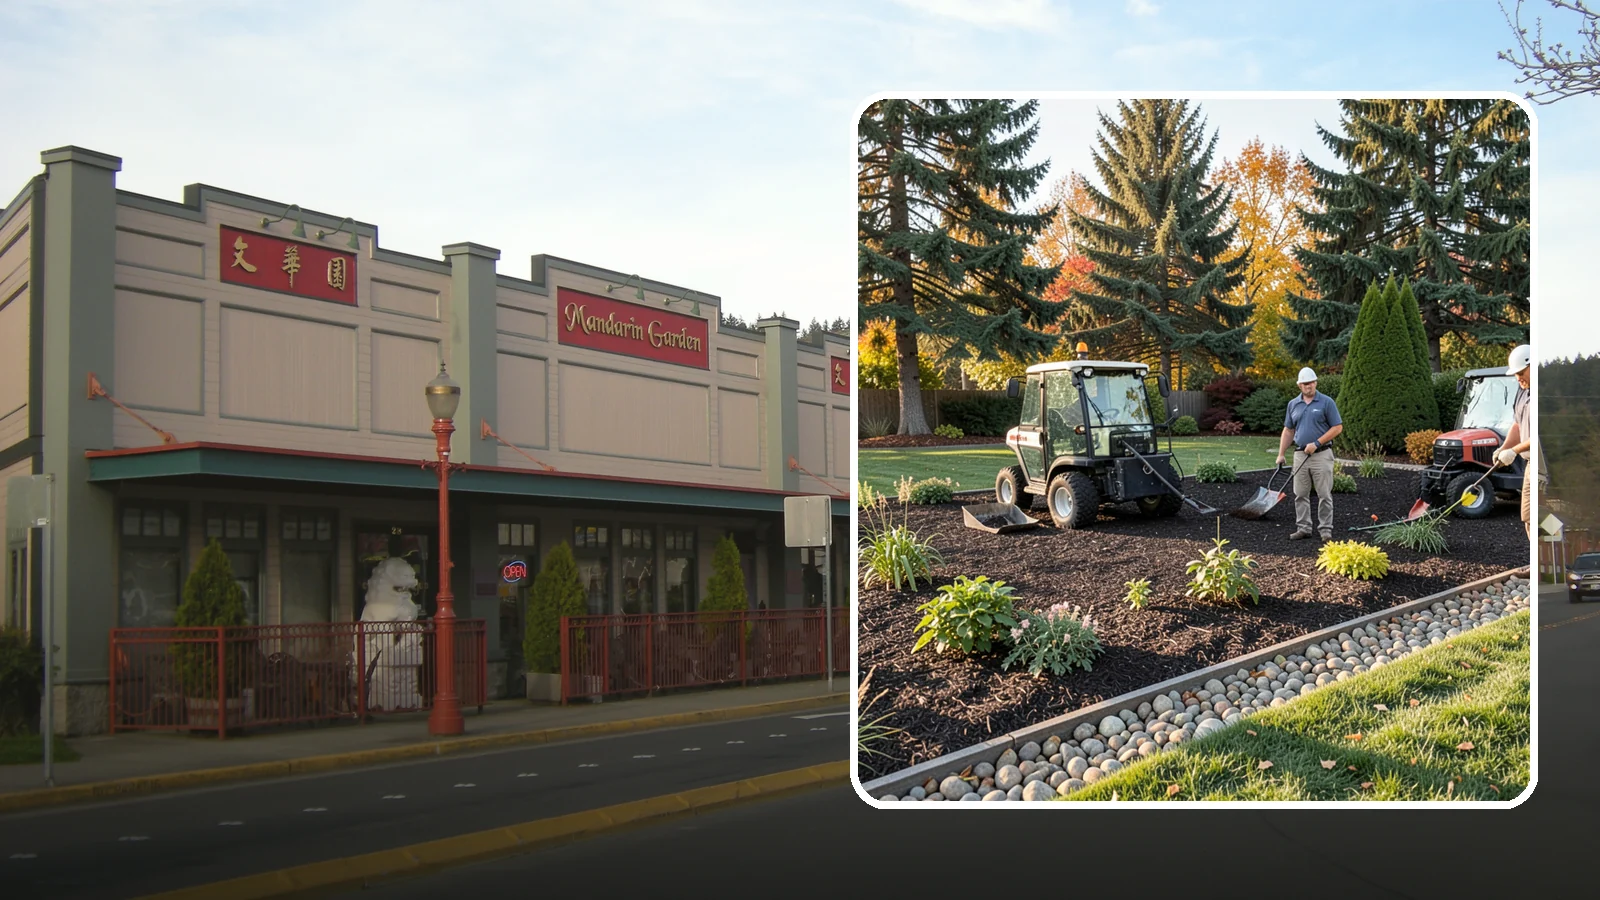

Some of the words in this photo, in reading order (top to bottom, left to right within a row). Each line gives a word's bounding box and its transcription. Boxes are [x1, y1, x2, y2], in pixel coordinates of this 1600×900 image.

[230, 235, 346, 291] 文華園
[564, 302, 644, 341] Mandarin
[648, 320, 701, 352] Garden
[503, 565, 527, 578] OPEN
